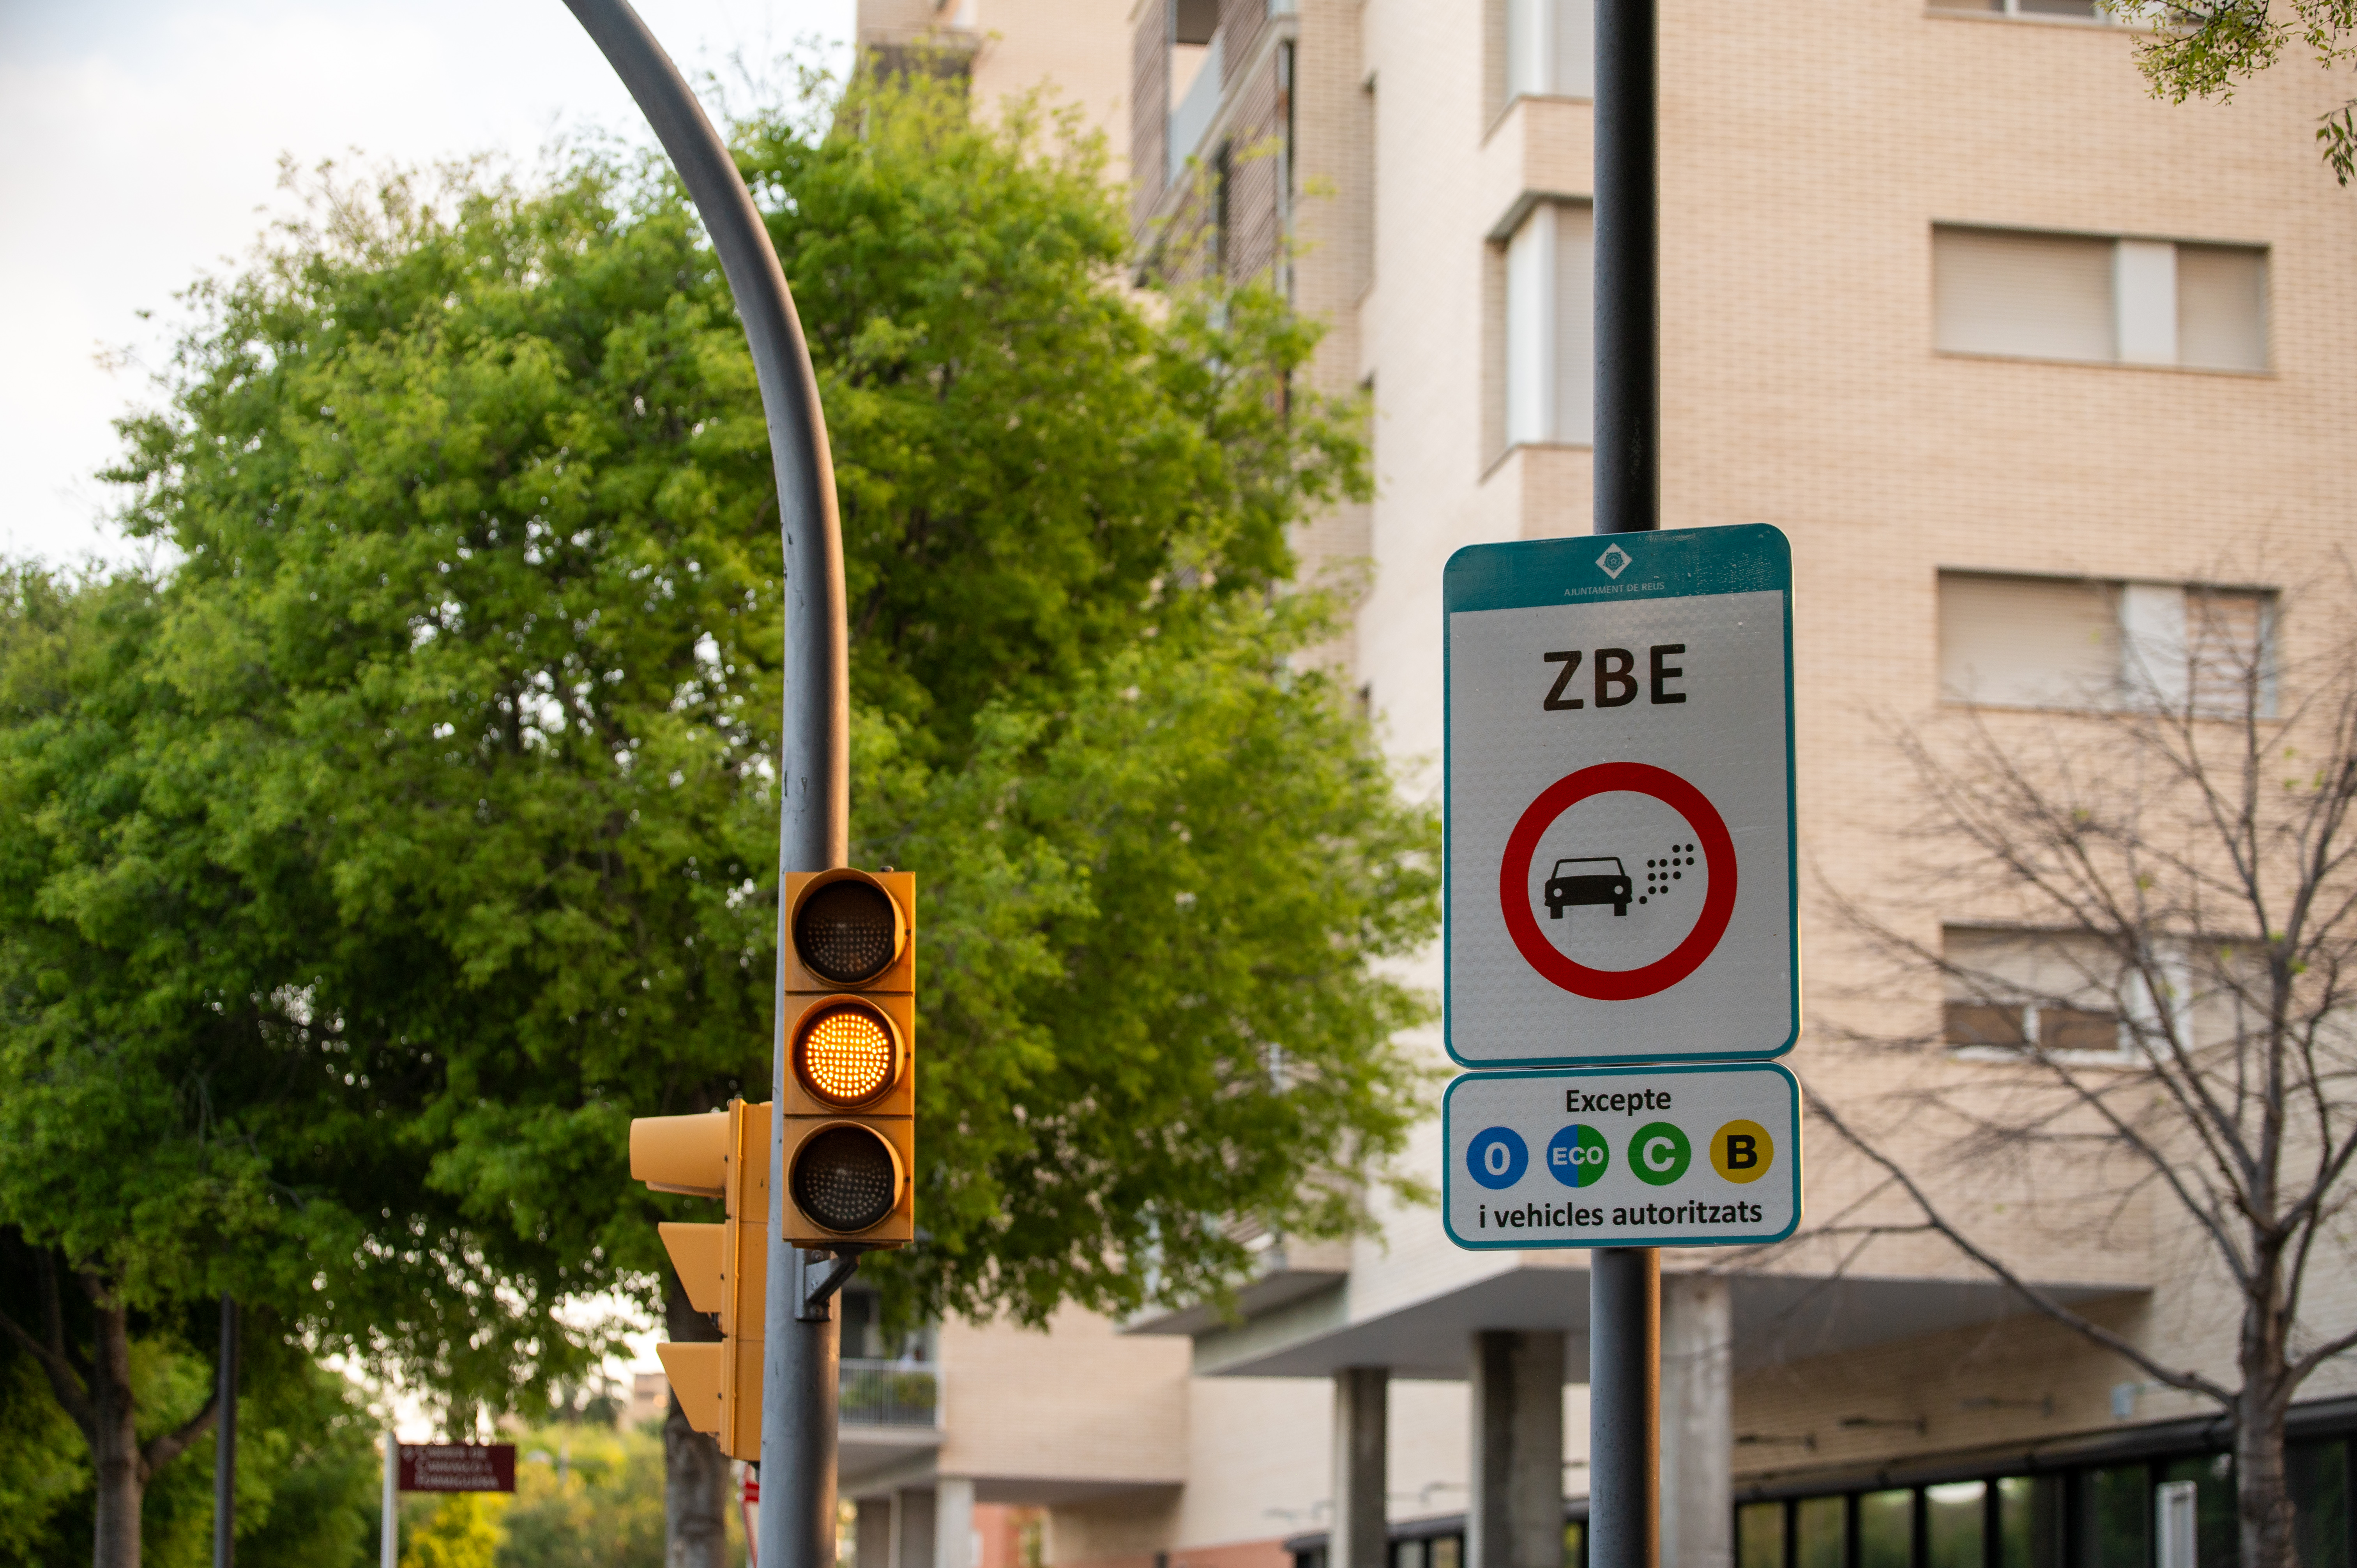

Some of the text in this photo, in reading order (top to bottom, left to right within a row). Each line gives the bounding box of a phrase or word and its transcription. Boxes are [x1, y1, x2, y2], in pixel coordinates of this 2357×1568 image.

[1564, 582, 1664, 596] AJUNTAMENT DE REUS
[1543, 643, 1686, 711] ZBE
[1567, 1089, 1671, 1116] Excepte
[1553, 1147, 1604, 1165] ECO
[1643, 1136, 1675, 1172] C
[1727, 1134, 1758, 1169] B
[1480, 1200, 1762, 1228] i vehicles autoritzats
